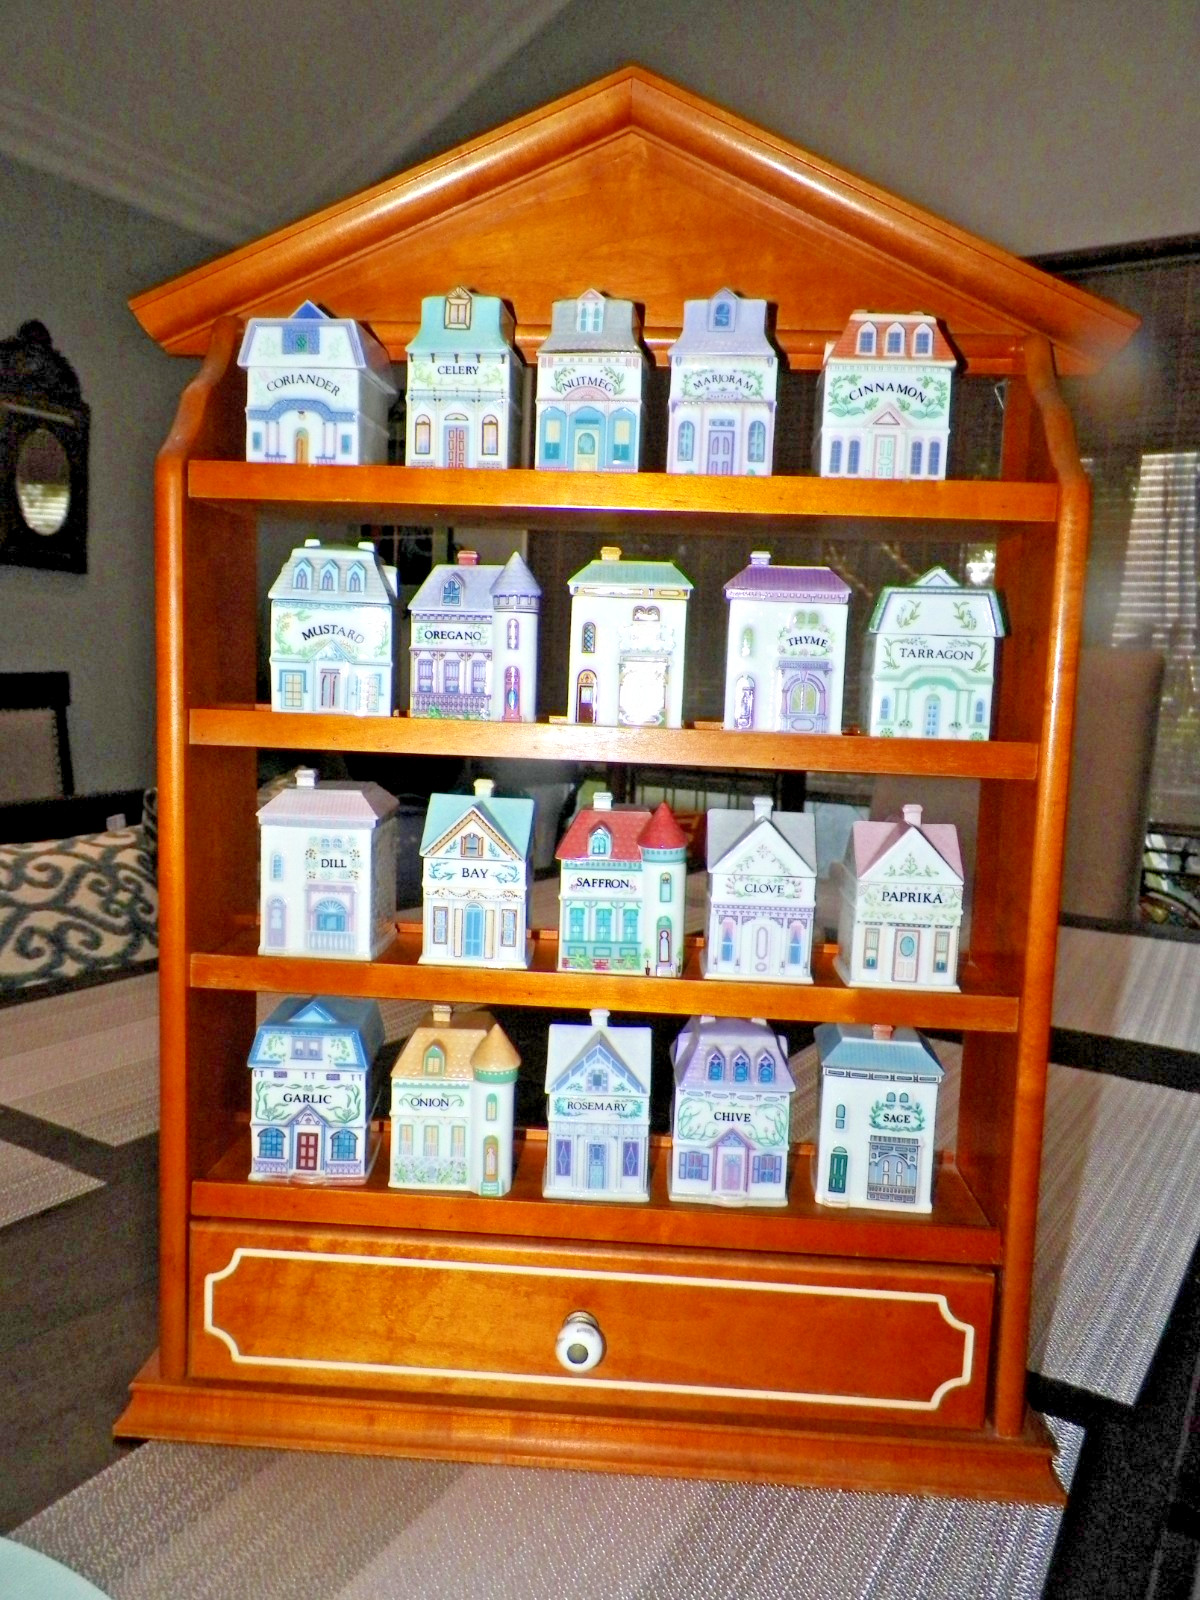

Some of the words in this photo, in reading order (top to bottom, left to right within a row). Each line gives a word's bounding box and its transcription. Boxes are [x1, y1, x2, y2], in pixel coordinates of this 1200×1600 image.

[437, 365, 479, 376] CELERY
[266, 373, 342, 396] CORIANDER
[562, 376, 614, 393] NUTMEG
[693, 374, 754, 391] MARJORAM
[849, 382, 927, 404] CINNAMON
[301, 624, 365, 644] MUSTARD
[424, 630, 482, 641] OREGANO
[787, 635, 828, 648] THYME
[899, 647, 974, 661] TARRAGON
[321, 858, 347, 869] DILL
[461, 867, 489, 879] BAY
[576, 877, 630, 889] SAFFRON
[744, 883, 785, 894] CLOVE
[881, 891, 943, 904] PAPRIKA
[283, 1093, 332, 1104] GARLIC
[410, 1097, 450, 1107] ONION
[567, 1101, 628, 1112] ROSEMARY
[714, 1111, 751, 1123] CHIVE
[883, 1113, 911, 1124] SAGE
